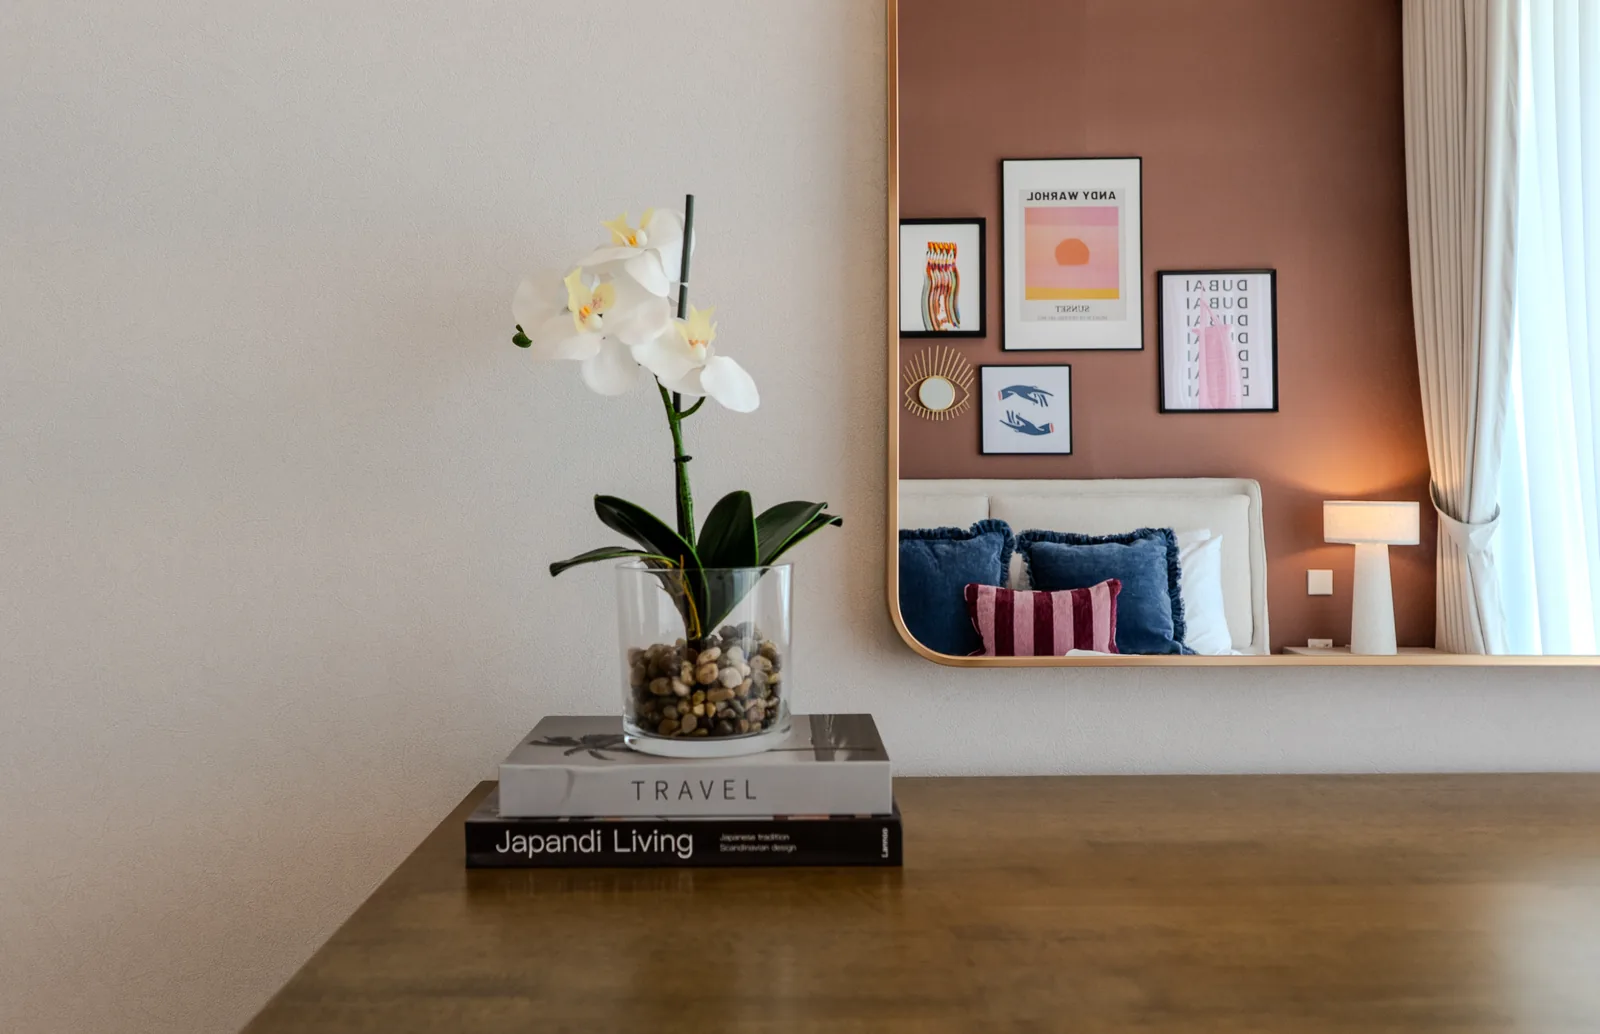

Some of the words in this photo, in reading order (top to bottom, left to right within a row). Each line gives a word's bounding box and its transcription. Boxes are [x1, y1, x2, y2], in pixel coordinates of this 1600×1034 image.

[631, 779, 757, 801] TRAVEL
[495, 829, 602, 859] Japandi
[613, 829, 694, 859] Living
[720, 833, 756, 842] Japanese
[758, 833, 790, 841] tradition
[720, 844, 769, 852] Scandinavian
[772, 844, 797, 853] design
